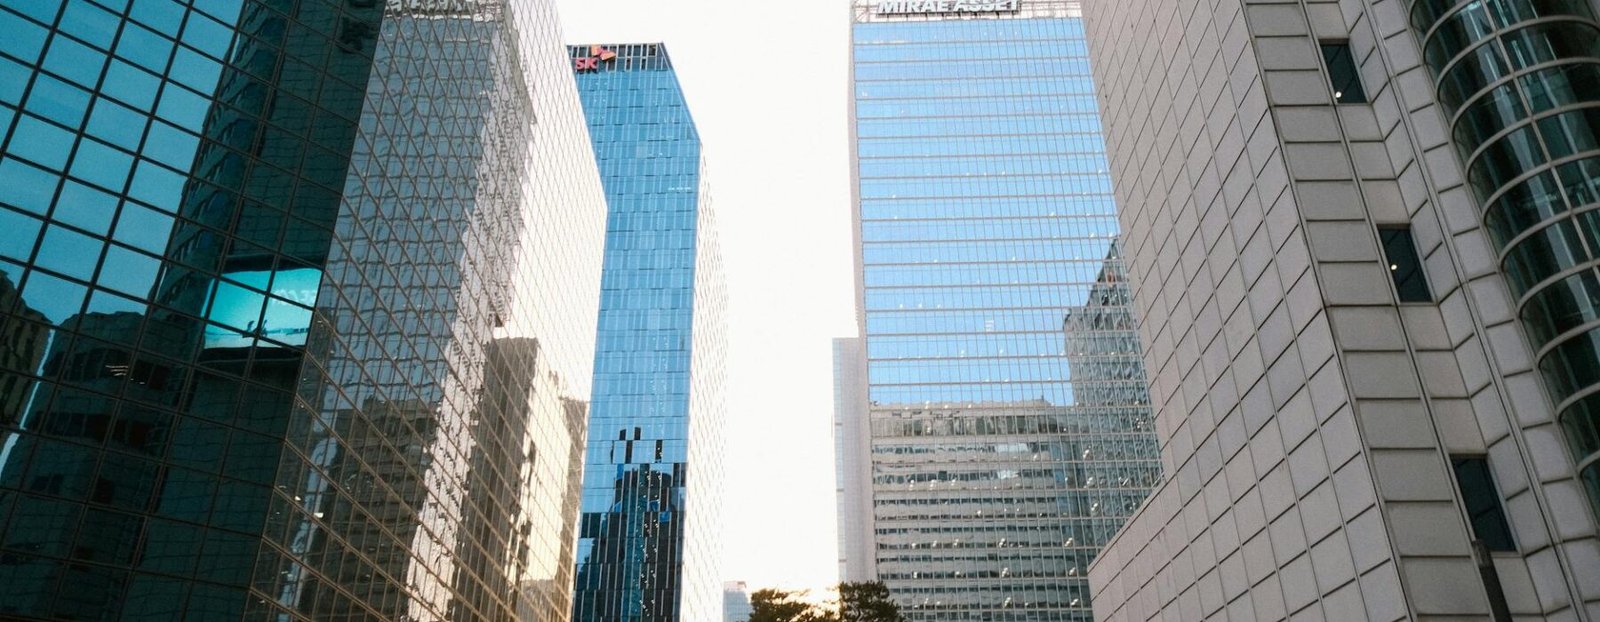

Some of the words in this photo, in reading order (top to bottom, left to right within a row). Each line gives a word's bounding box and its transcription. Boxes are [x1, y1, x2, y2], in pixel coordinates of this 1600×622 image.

[877, 0, 949, 14] MIRAE
[952, 0, 1018, 12] ASSET
[575, 57, 598, 70] SK
